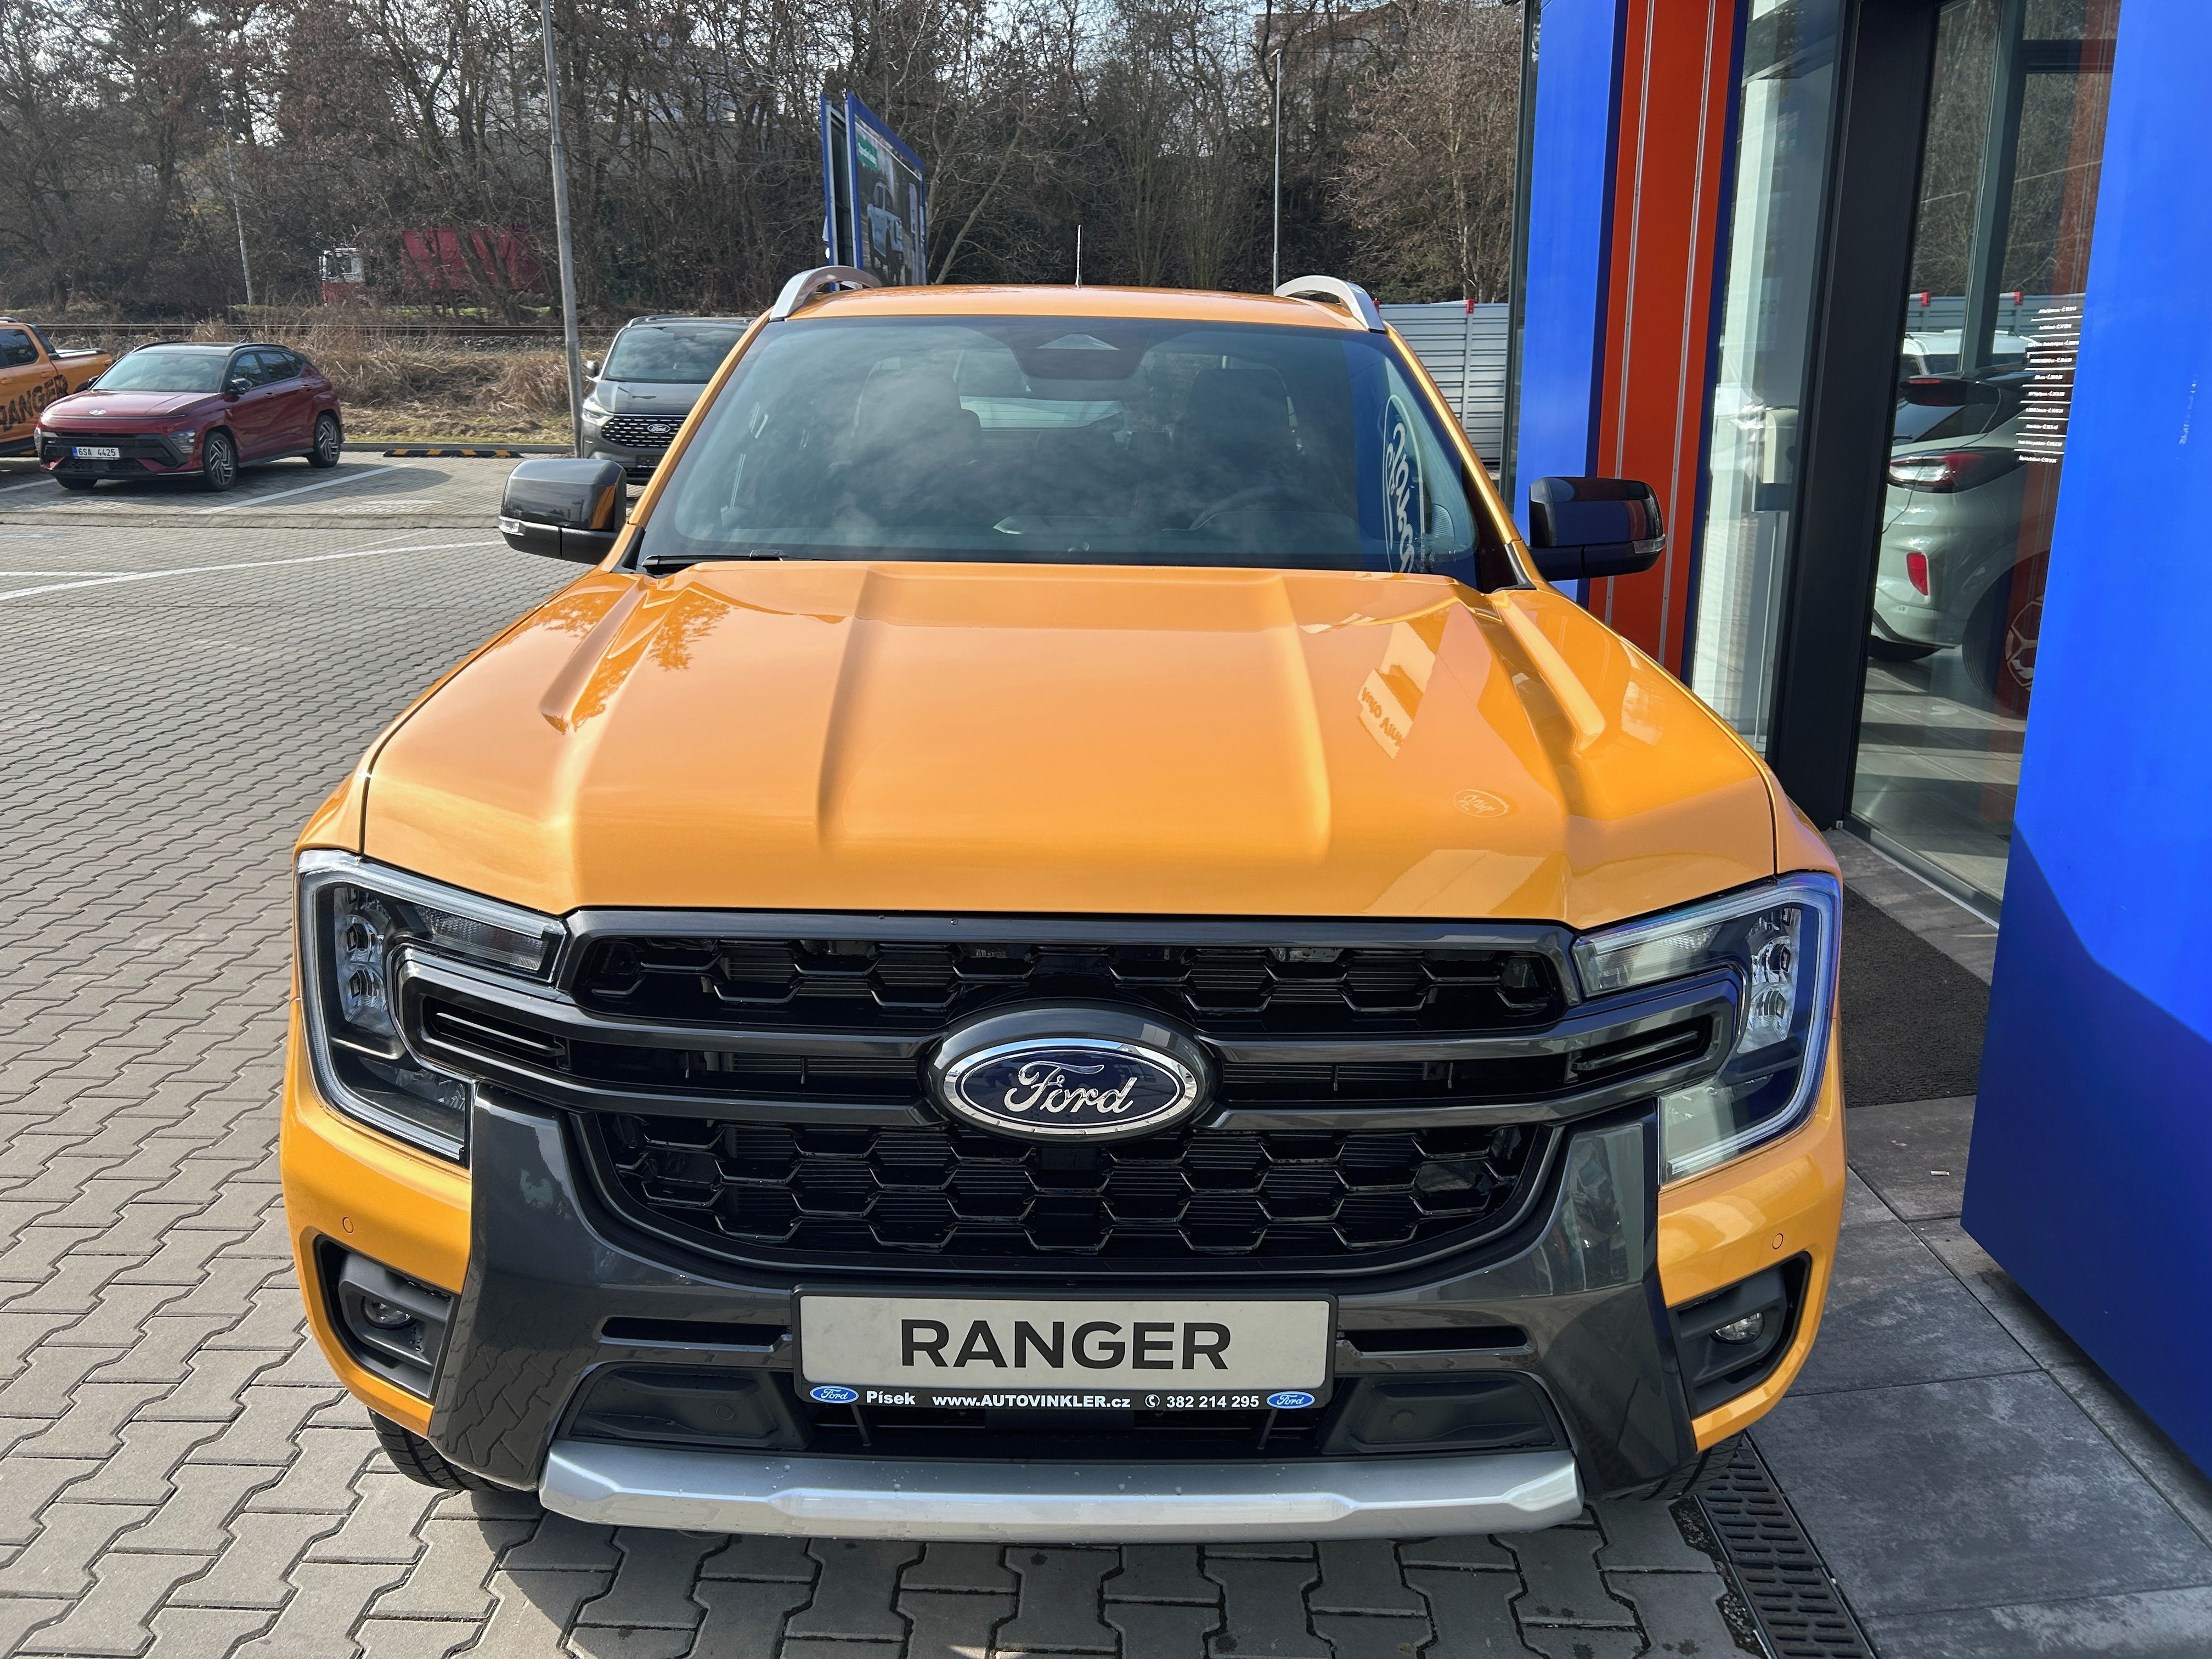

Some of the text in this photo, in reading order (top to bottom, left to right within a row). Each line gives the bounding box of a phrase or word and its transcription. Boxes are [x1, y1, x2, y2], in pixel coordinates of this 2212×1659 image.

[78, 448, 116, 456] 6SA 4425
[1003, 1060, 1138, 1114] Ford
[901, 1318, 1231, 1370] RANGER
[820, 1387, 1304, 1408] Ford Písek www.AUTOVINKLER.cz 382 214 295 Ford
